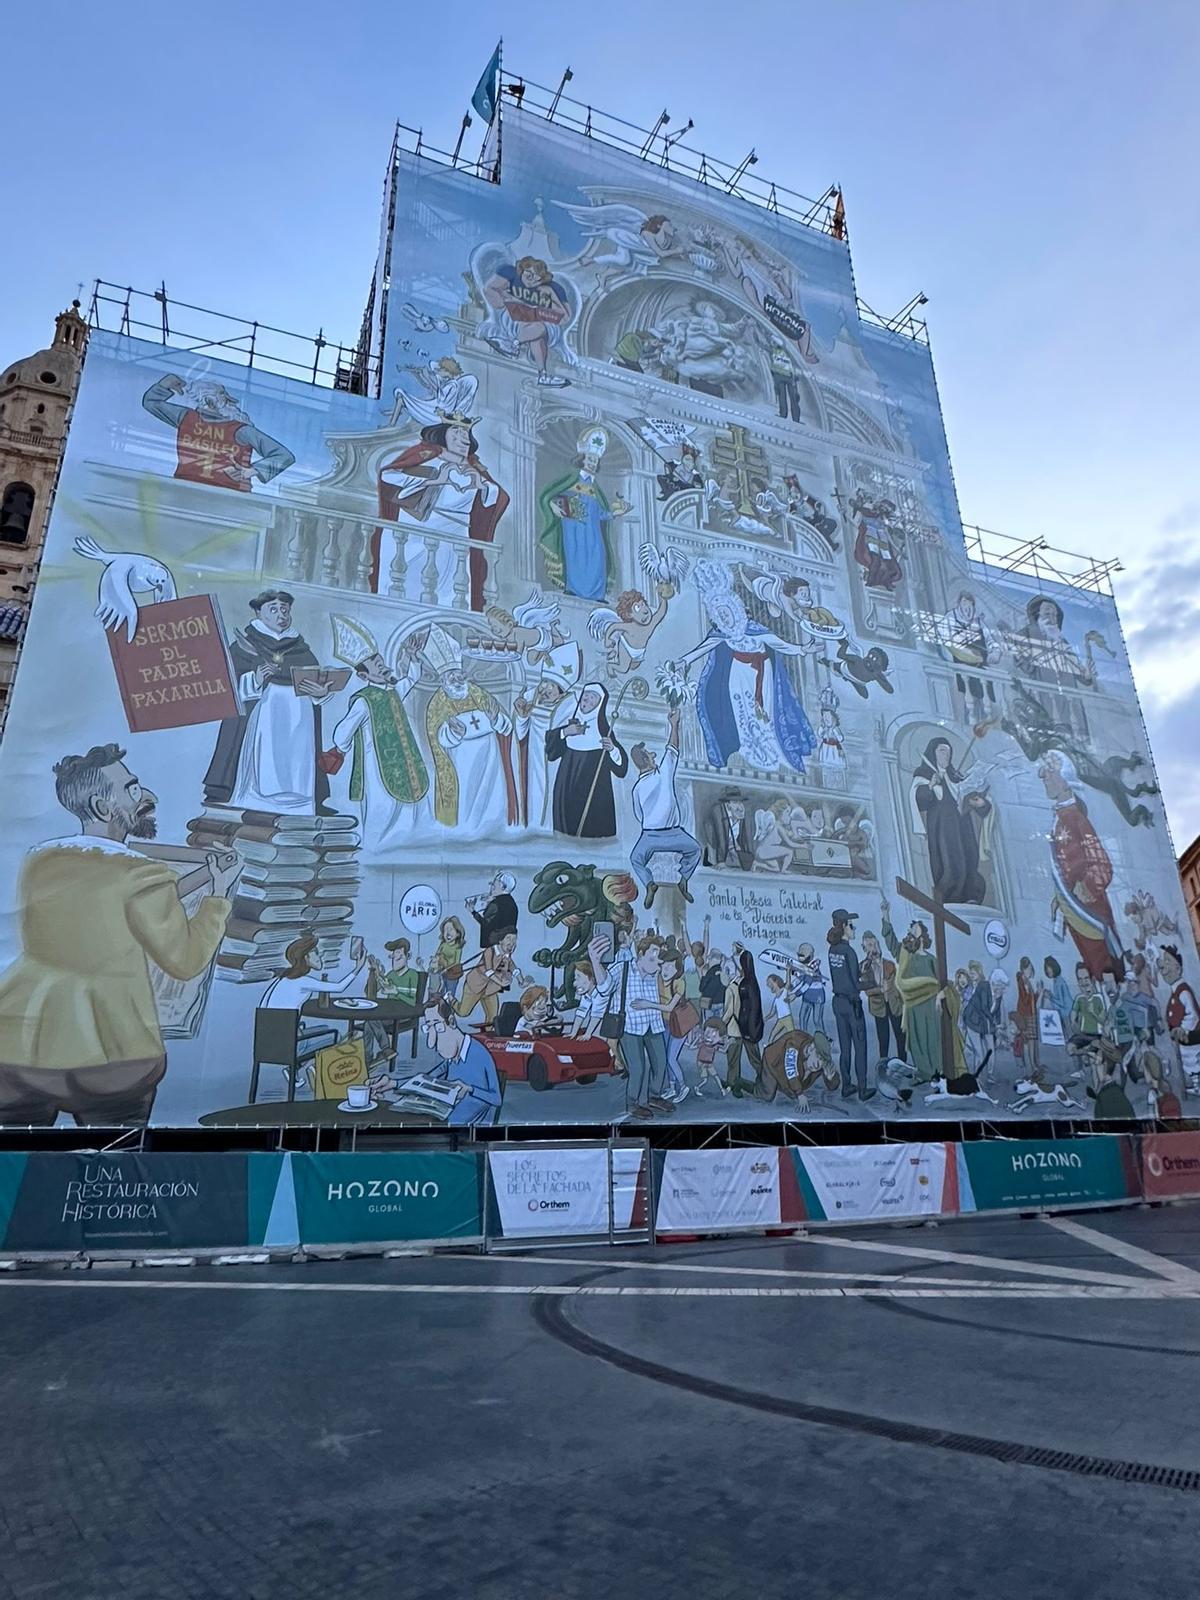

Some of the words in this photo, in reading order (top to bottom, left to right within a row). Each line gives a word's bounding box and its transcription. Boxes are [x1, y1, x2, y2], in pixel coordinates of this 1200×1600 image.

[765, 302, 805, 334] HOZONO
[193, 421, 225, 442] SAN
[134, 615, 210, 646] SERMÓN
[138, 659, 202, 684] PADRE
[131, 678, 227, 709] PAXARILLA
[708, 883, 737, 907] Santa
[737, 886, 772, 913] Iglesia
[779, 888, 824, 911] Catedral
[720, 910, 731, 920] de
[733, 909, 742, 921] la
[795, 916, 808, 924] de
[742, 920, 791, 946] Cartagena
[515, 1160, 537, 1171] LOS
[1012, 1152, 1082, 1172] HOZONO
[84, 1164, 123, 1183] UNA
[507, 1170, 567, 1185] SECRETOS
[66, 1180, 200, 1203] RESTAURACIÓN
[327, 1179, 440, 1201] HOZONO
[507, 1183, 521, 1195] DE
[523, 1182, 538, 1195] LA
[543, 1181, 592, 1193] FACHADA
[61, 1202, 157, 1222] HISTÓRICA
[368, 1204, 402, 1213] GLOBAL
[540, 1200, 570, 1209] Orthem
